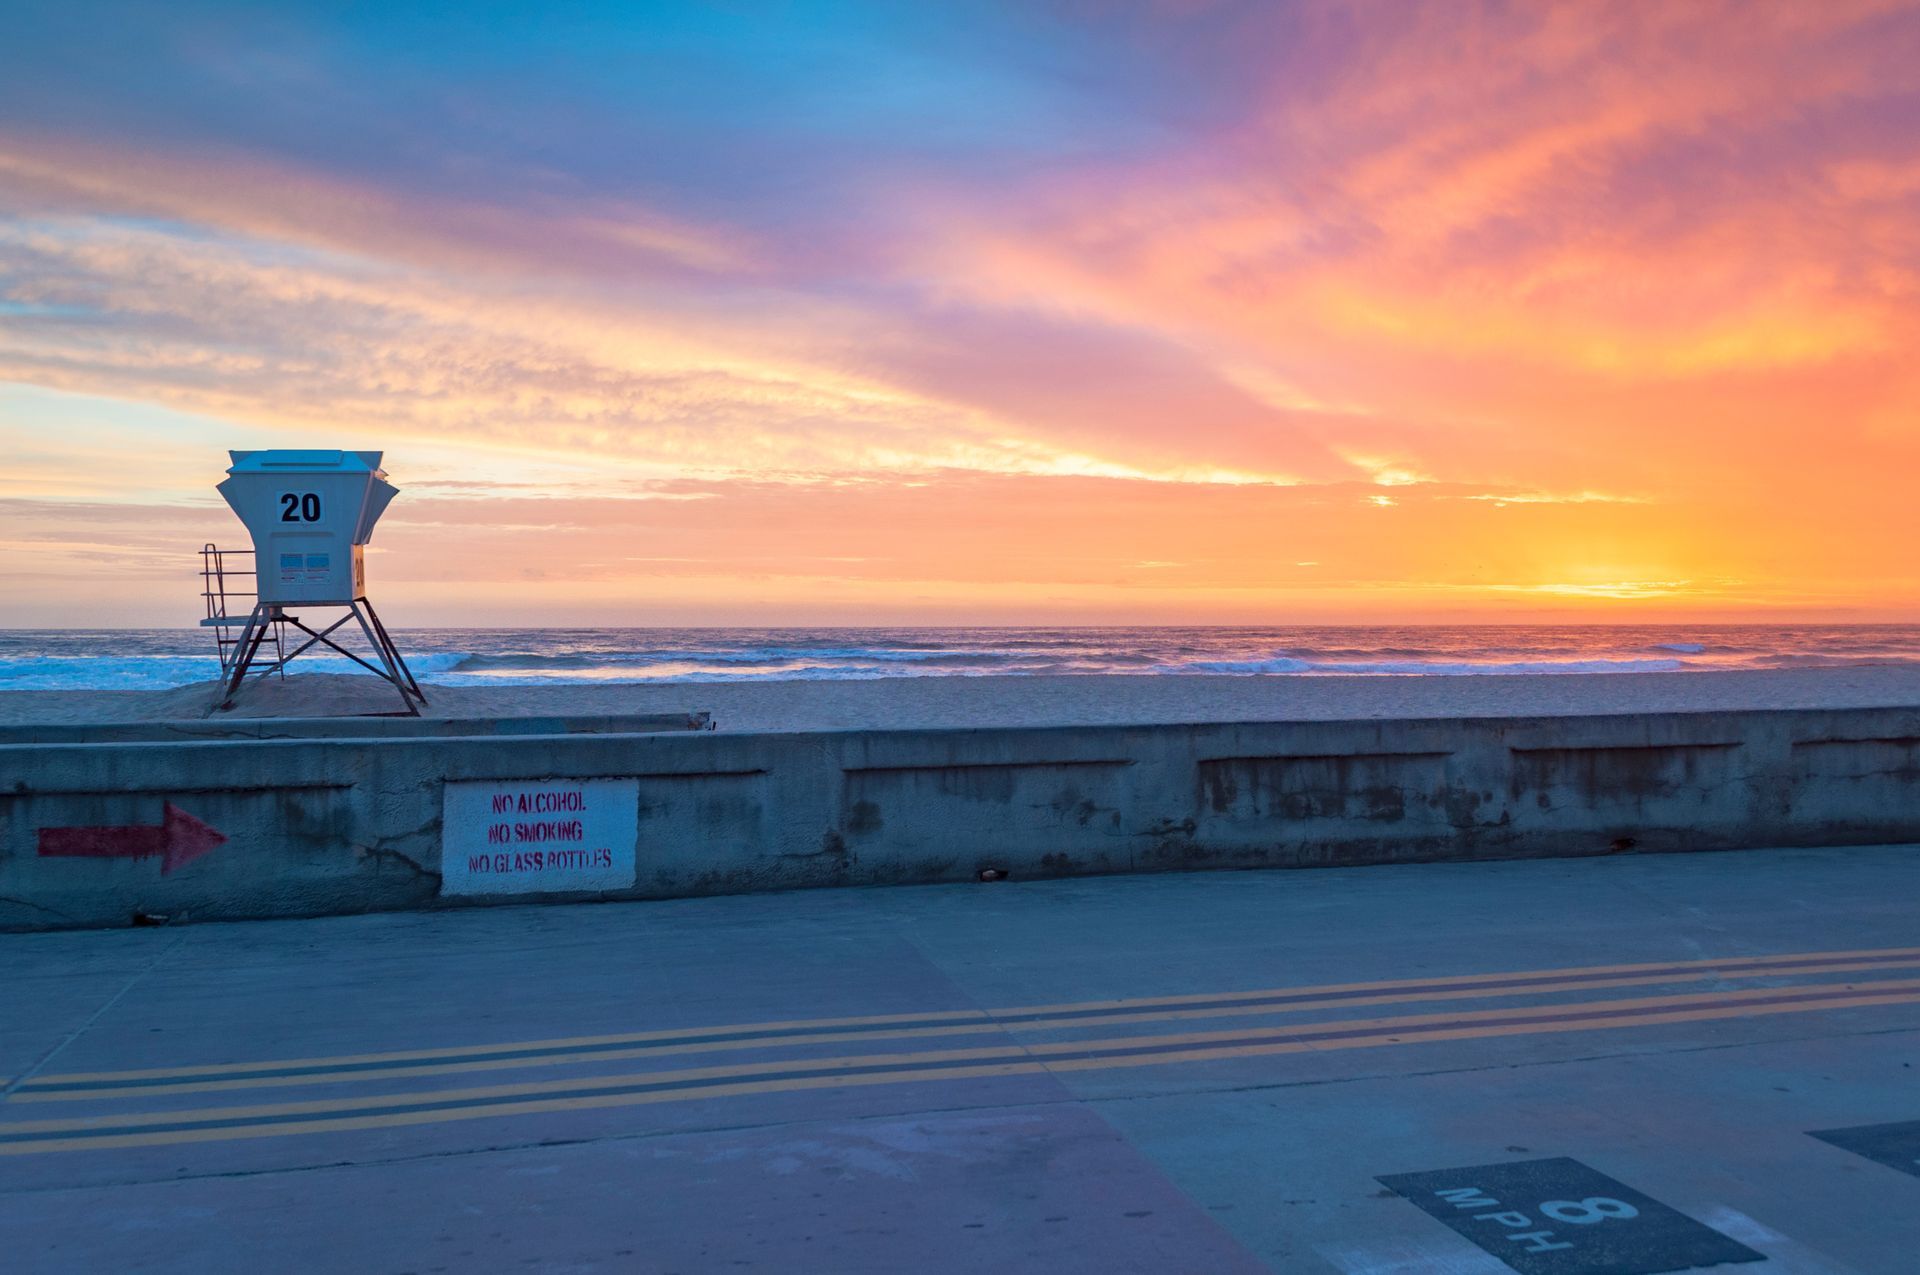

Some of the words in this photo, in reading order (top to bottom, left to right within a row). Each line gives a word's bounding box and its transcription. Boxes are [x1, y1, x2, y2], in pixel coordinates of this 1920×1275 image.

[281, 493, 320, 522] 20
[492, 794, 513, 815] NO
[518, 791, 587, 814] ALCOHOL
[488, 823, 511, 844] NO
[514, 820, 583, 843] SMOKING
[468, 854, 490, 873] NO
[494, 851, 544, 873] GLASS
[547, 848, 612, 870] BOTTLES
[1434, 1187, 1574, 1253] MPH
[1539, 1197, 1639, 1225] 8
